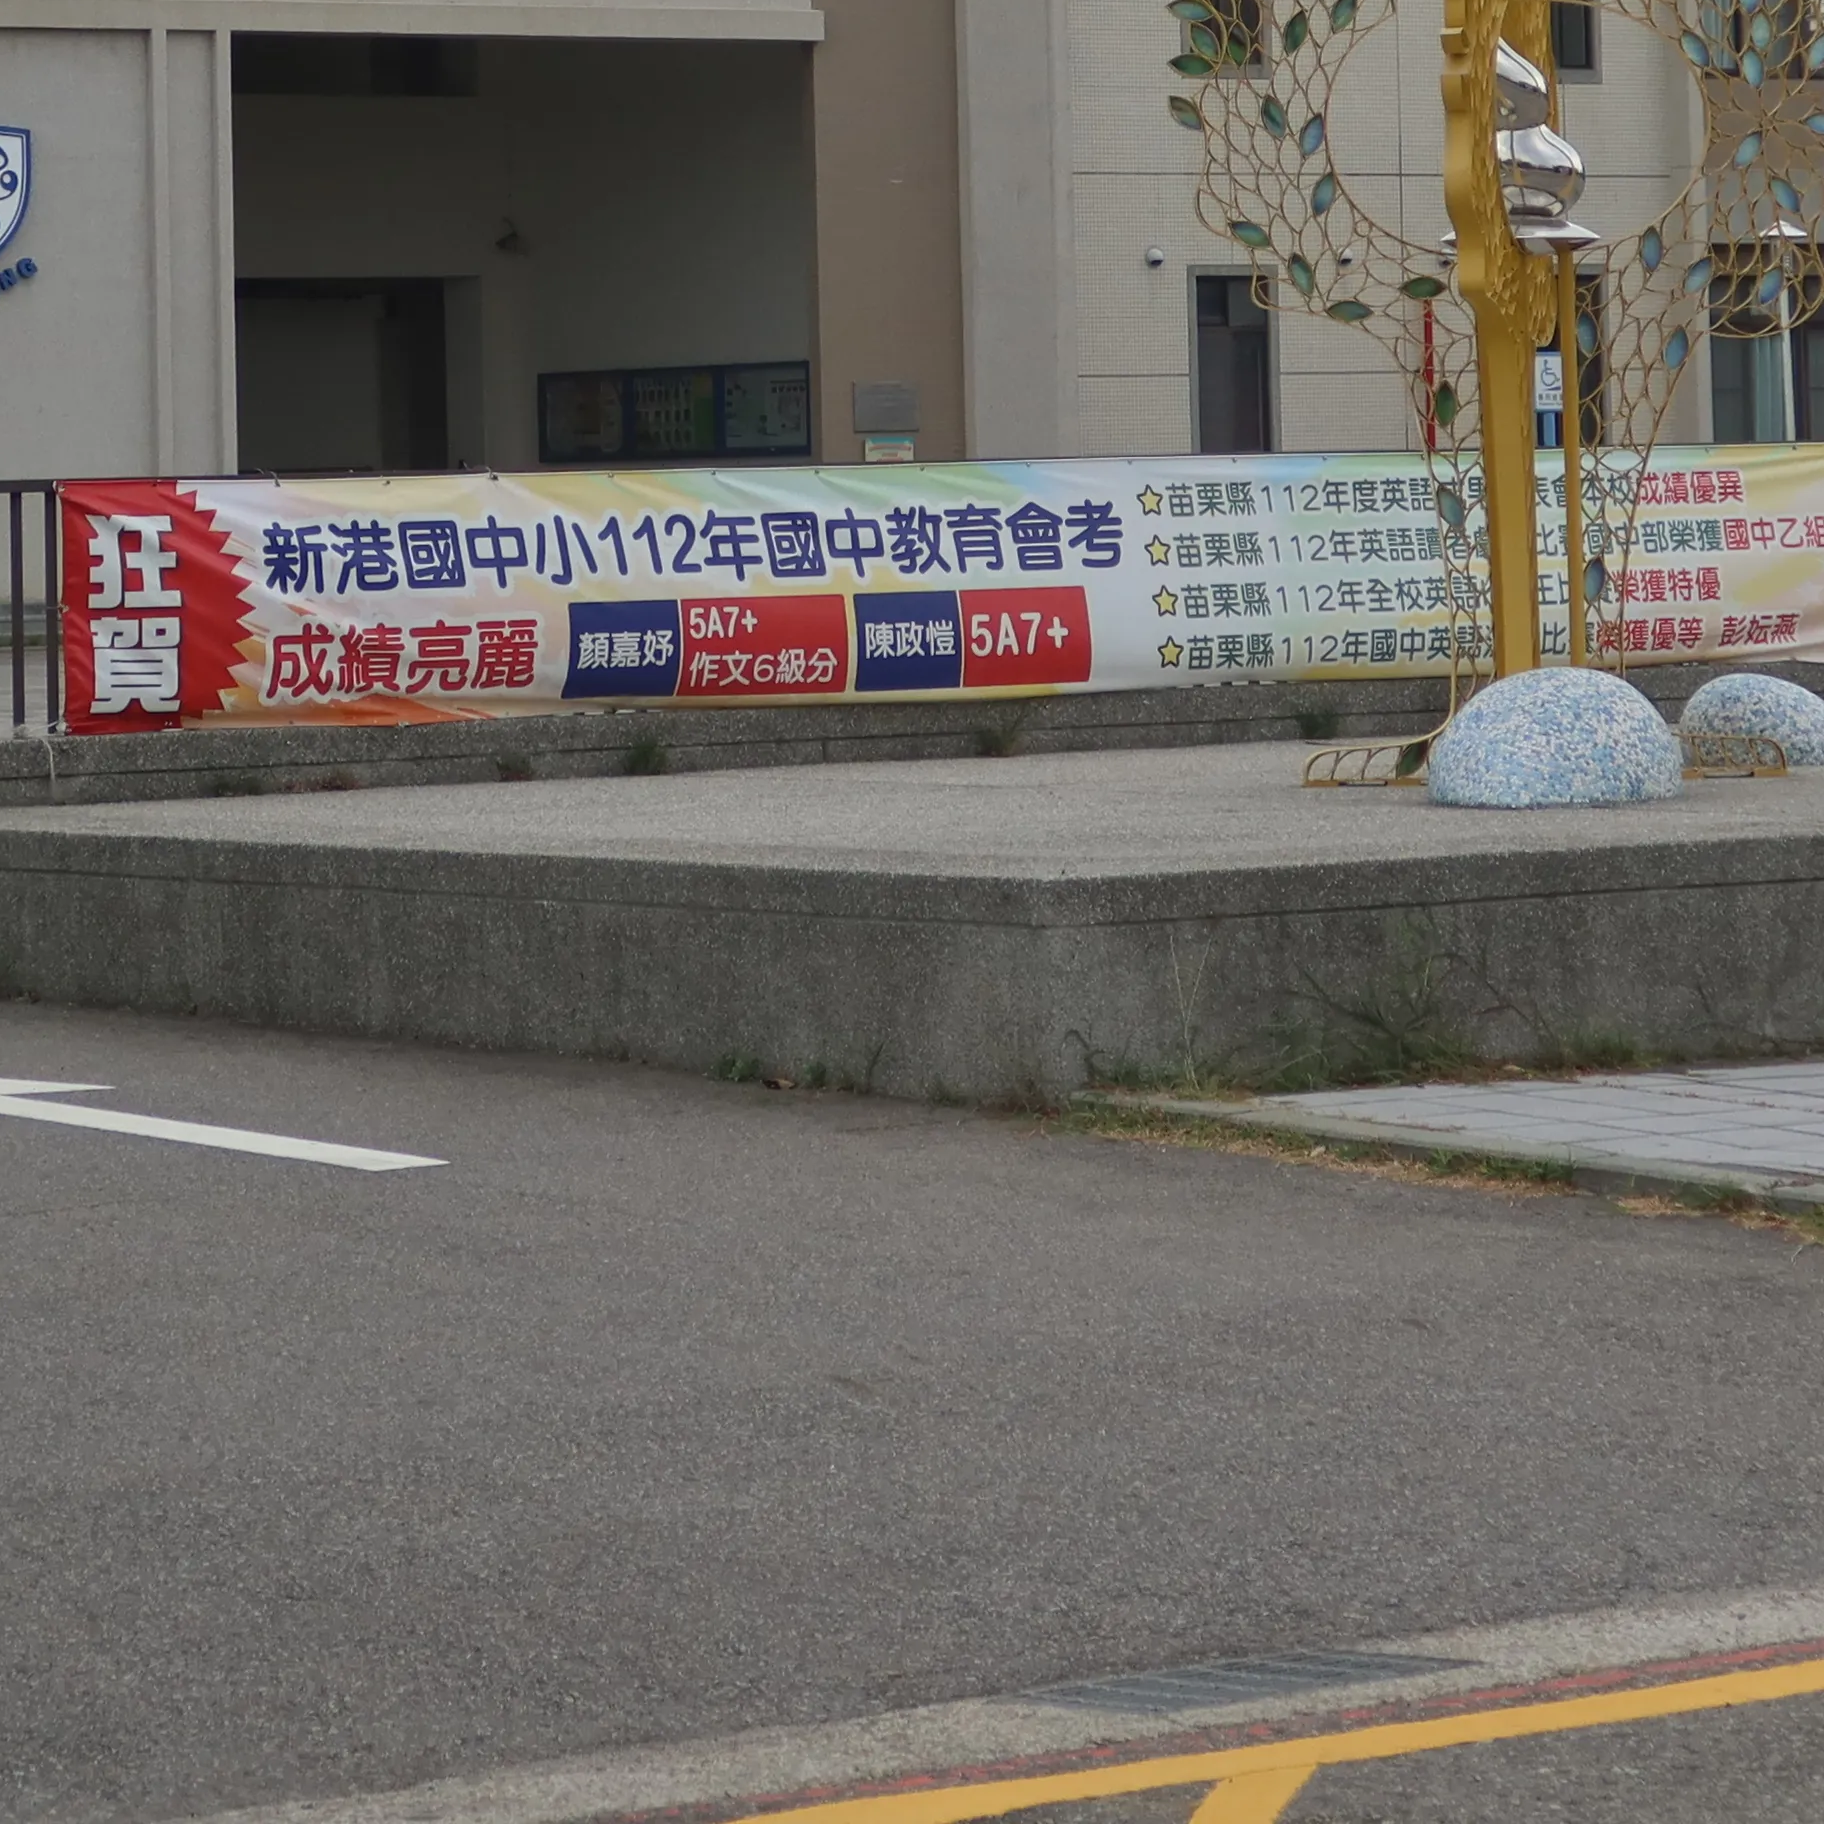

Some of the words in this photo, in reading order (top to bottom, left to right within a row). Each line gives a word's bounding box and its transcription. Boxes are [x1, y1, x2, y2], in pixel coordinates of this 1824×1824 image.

[260, 500, 1123, 595] 新港國中小112年國中教育會考
[85, 514, 182, 714] 狂賀
[689, 606, 758, 639] 5A7+
[1718, 613, 1800, 648] 彭妘燕
[577, 630, 673, 669] 顏嘉妤
[865, 620, 955, 659] 陳政愷
[971, 612, 1069, 657] 5A7+
[266, 619, 539, 699] 成績亮麗
[689, 647, 837, 687] 作文6級分
